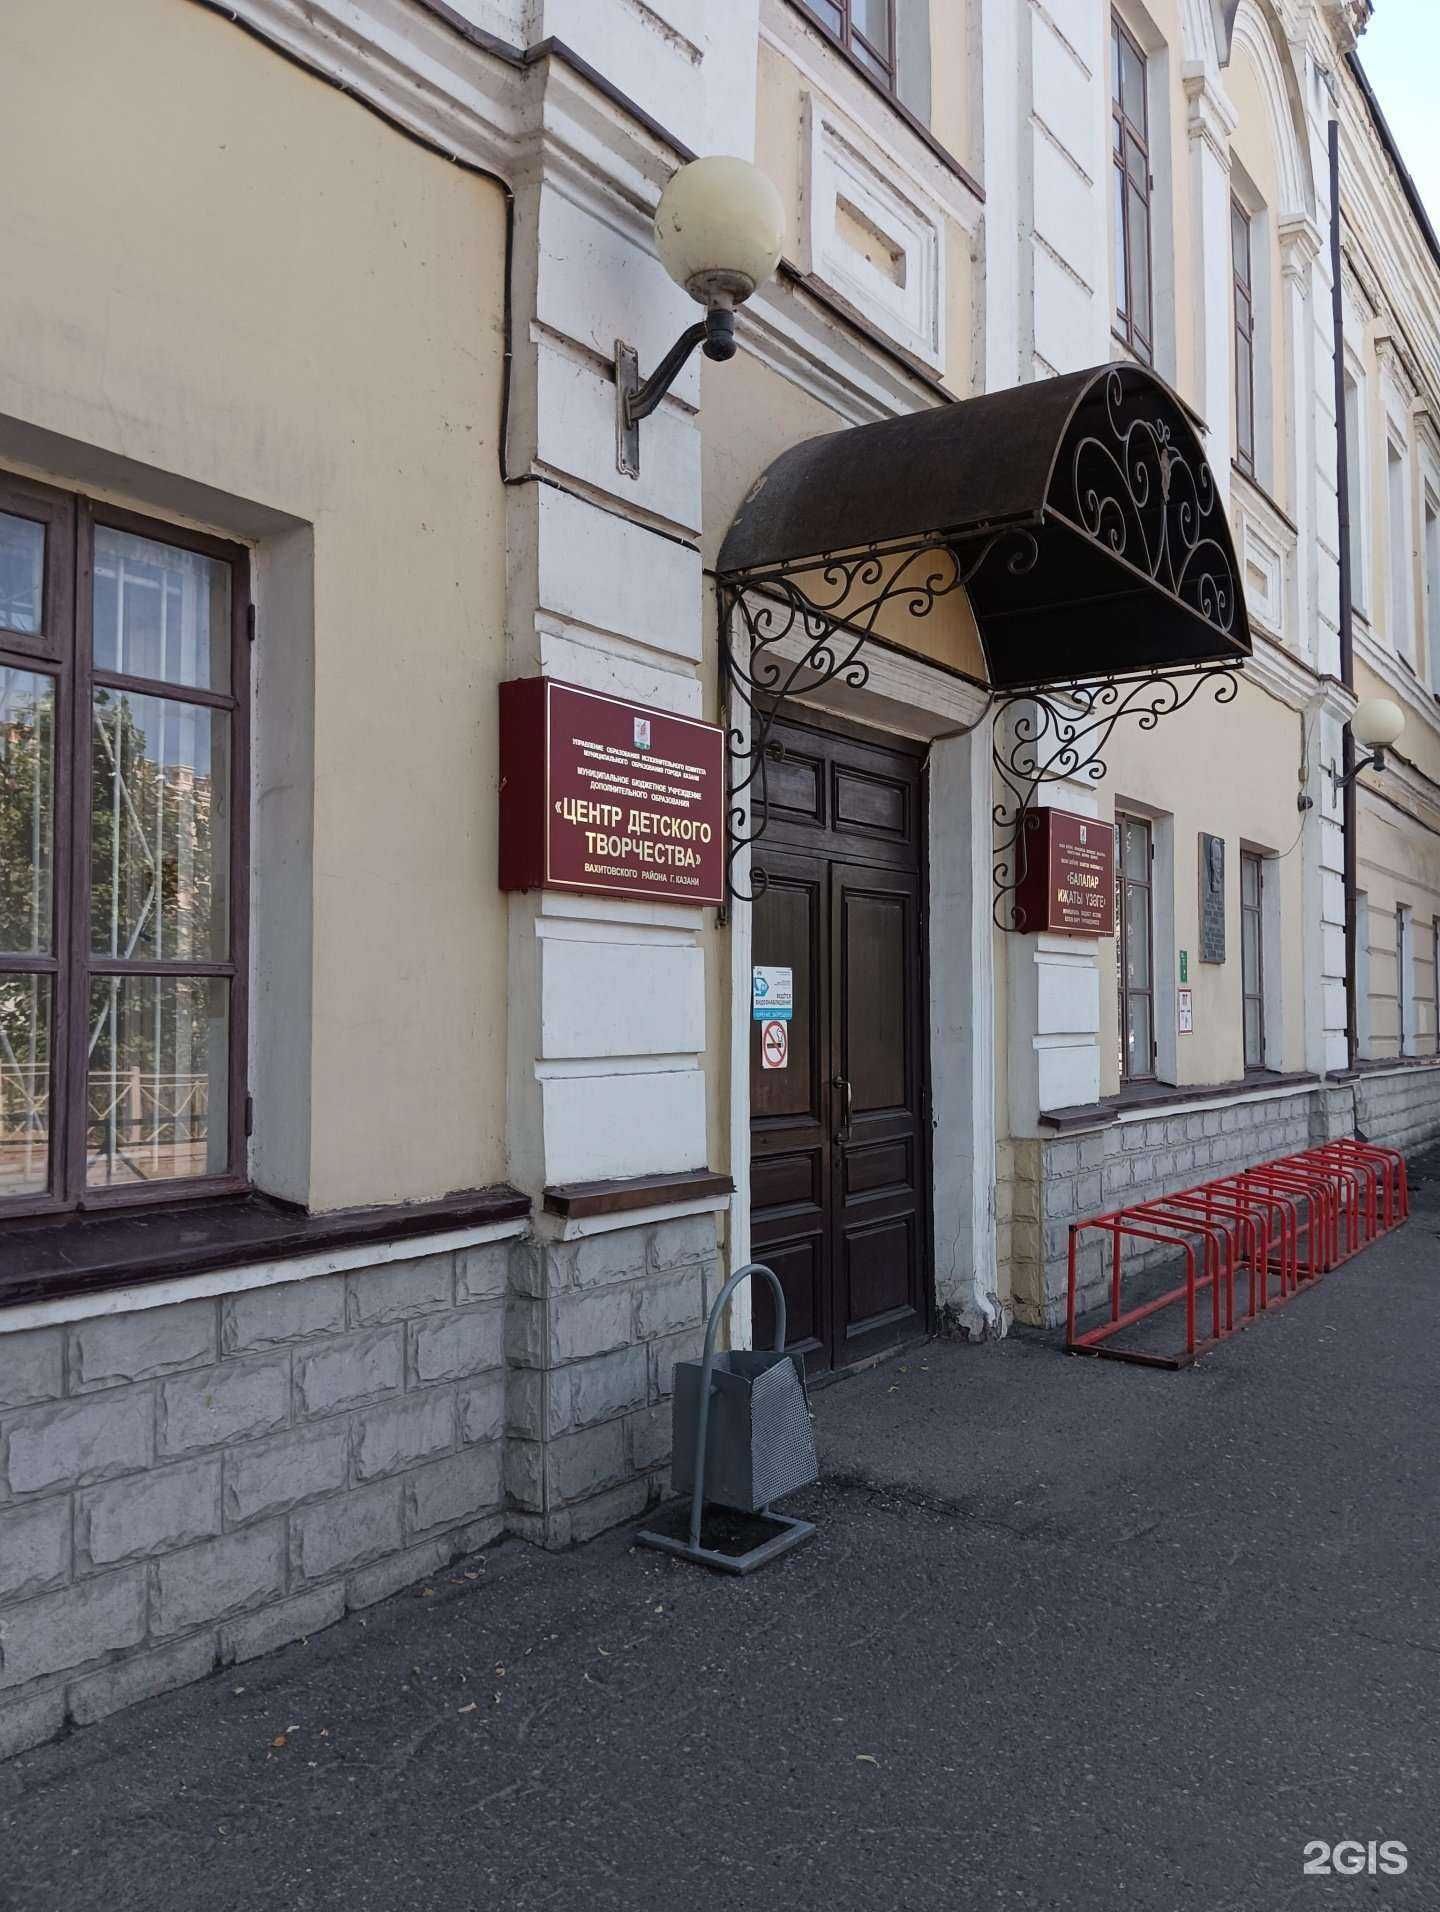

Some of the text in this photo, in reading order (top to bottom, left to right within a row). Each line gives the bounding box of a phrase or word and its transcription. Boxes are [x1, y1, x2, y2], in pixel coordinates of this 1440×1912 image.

[577, 766, 702, 801] МУНИЦИПАЛЬНОЕ БЮДЖЕТНОЕ УЧРЕЖДЕНИЕ
[590, 780, 690, 808] ДОПОЛНИТЕЛЬНОГО ОБРАЗОВАНИЯ
[554, 797, 712, 844] «ЦЕНТР ДЕТСКОГО
[585, 831, 702, 868] ТВОРЧЕСТВА»
[584, 863, 638, 879] ВАХИТОВСКОГО
[641, 870, 667, 883] РАЙОНА
